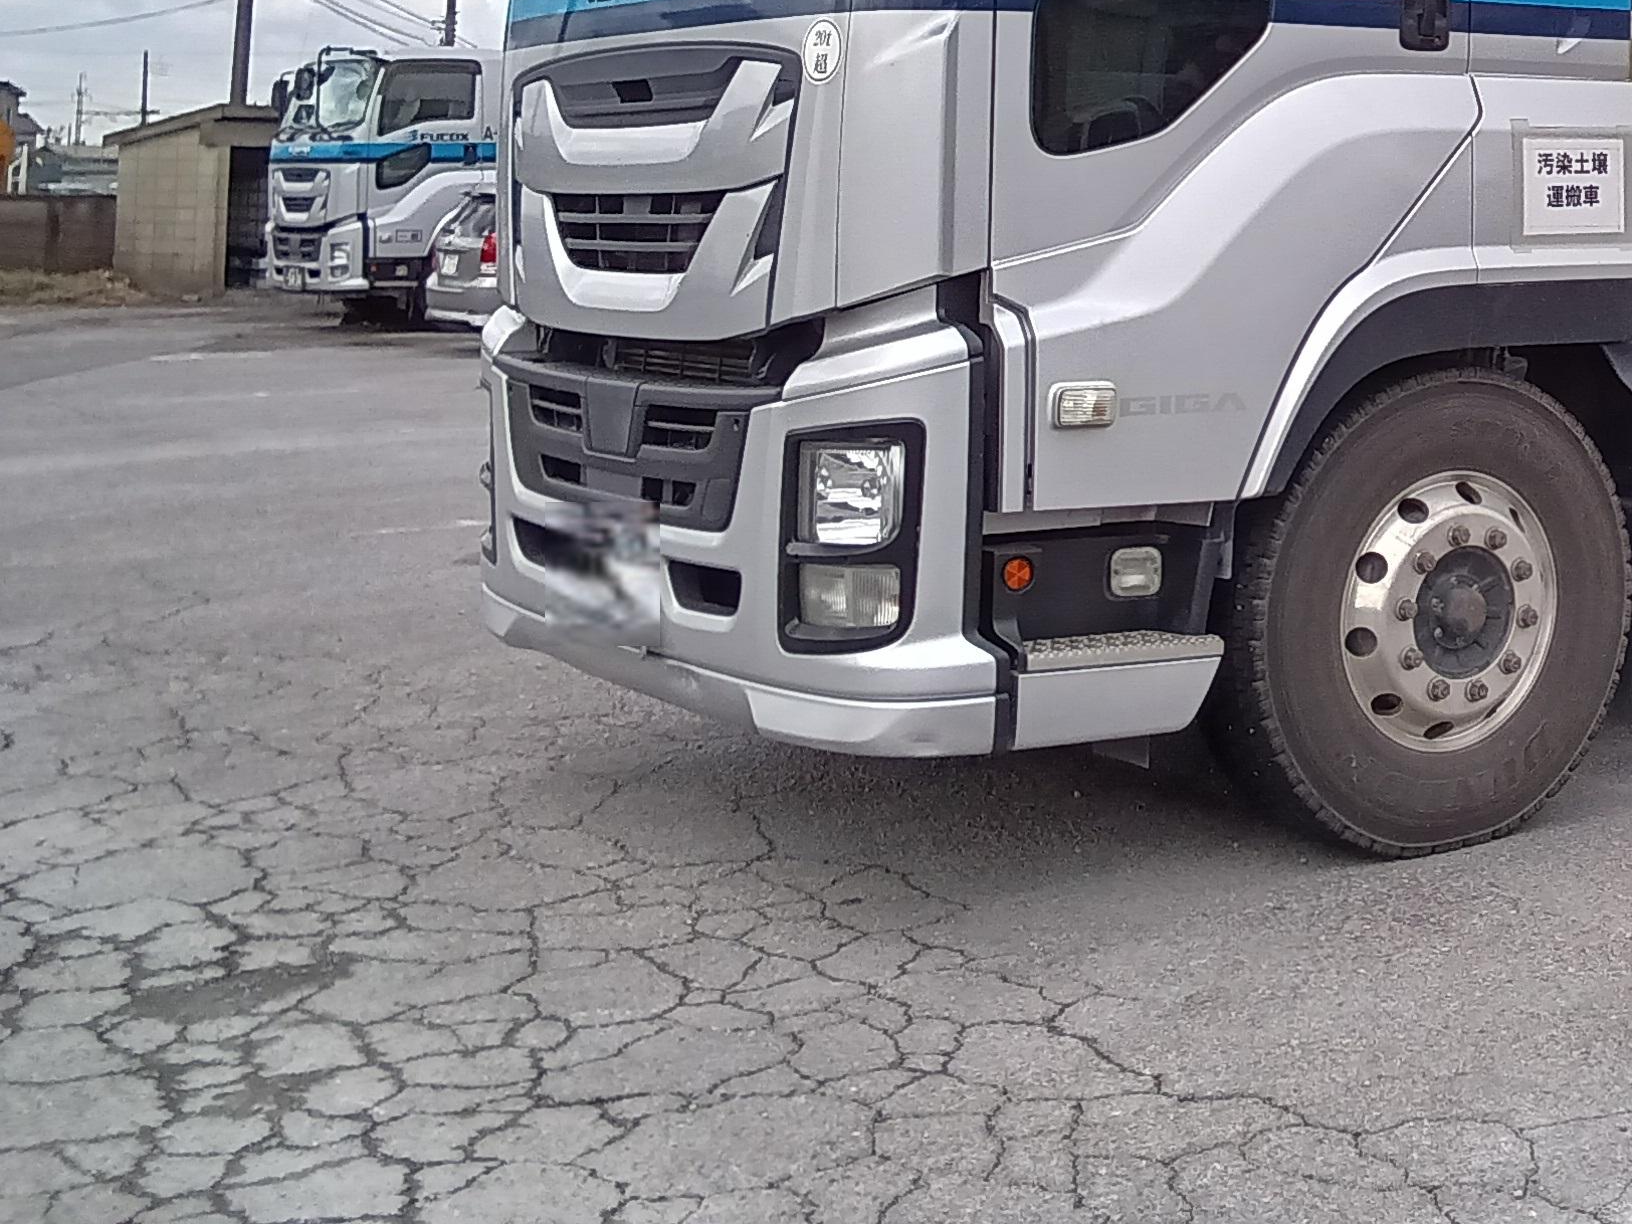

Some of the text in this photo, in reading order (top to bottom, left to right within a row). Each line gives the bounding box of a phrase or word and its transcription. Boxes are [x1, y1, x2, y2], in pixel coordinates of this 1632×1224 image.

[1537, 152, 1608, 175] 汚染土壌
[1546, 184, 1600, 208] 運搬車
[1119, 392, 1246, 417] GIGA
